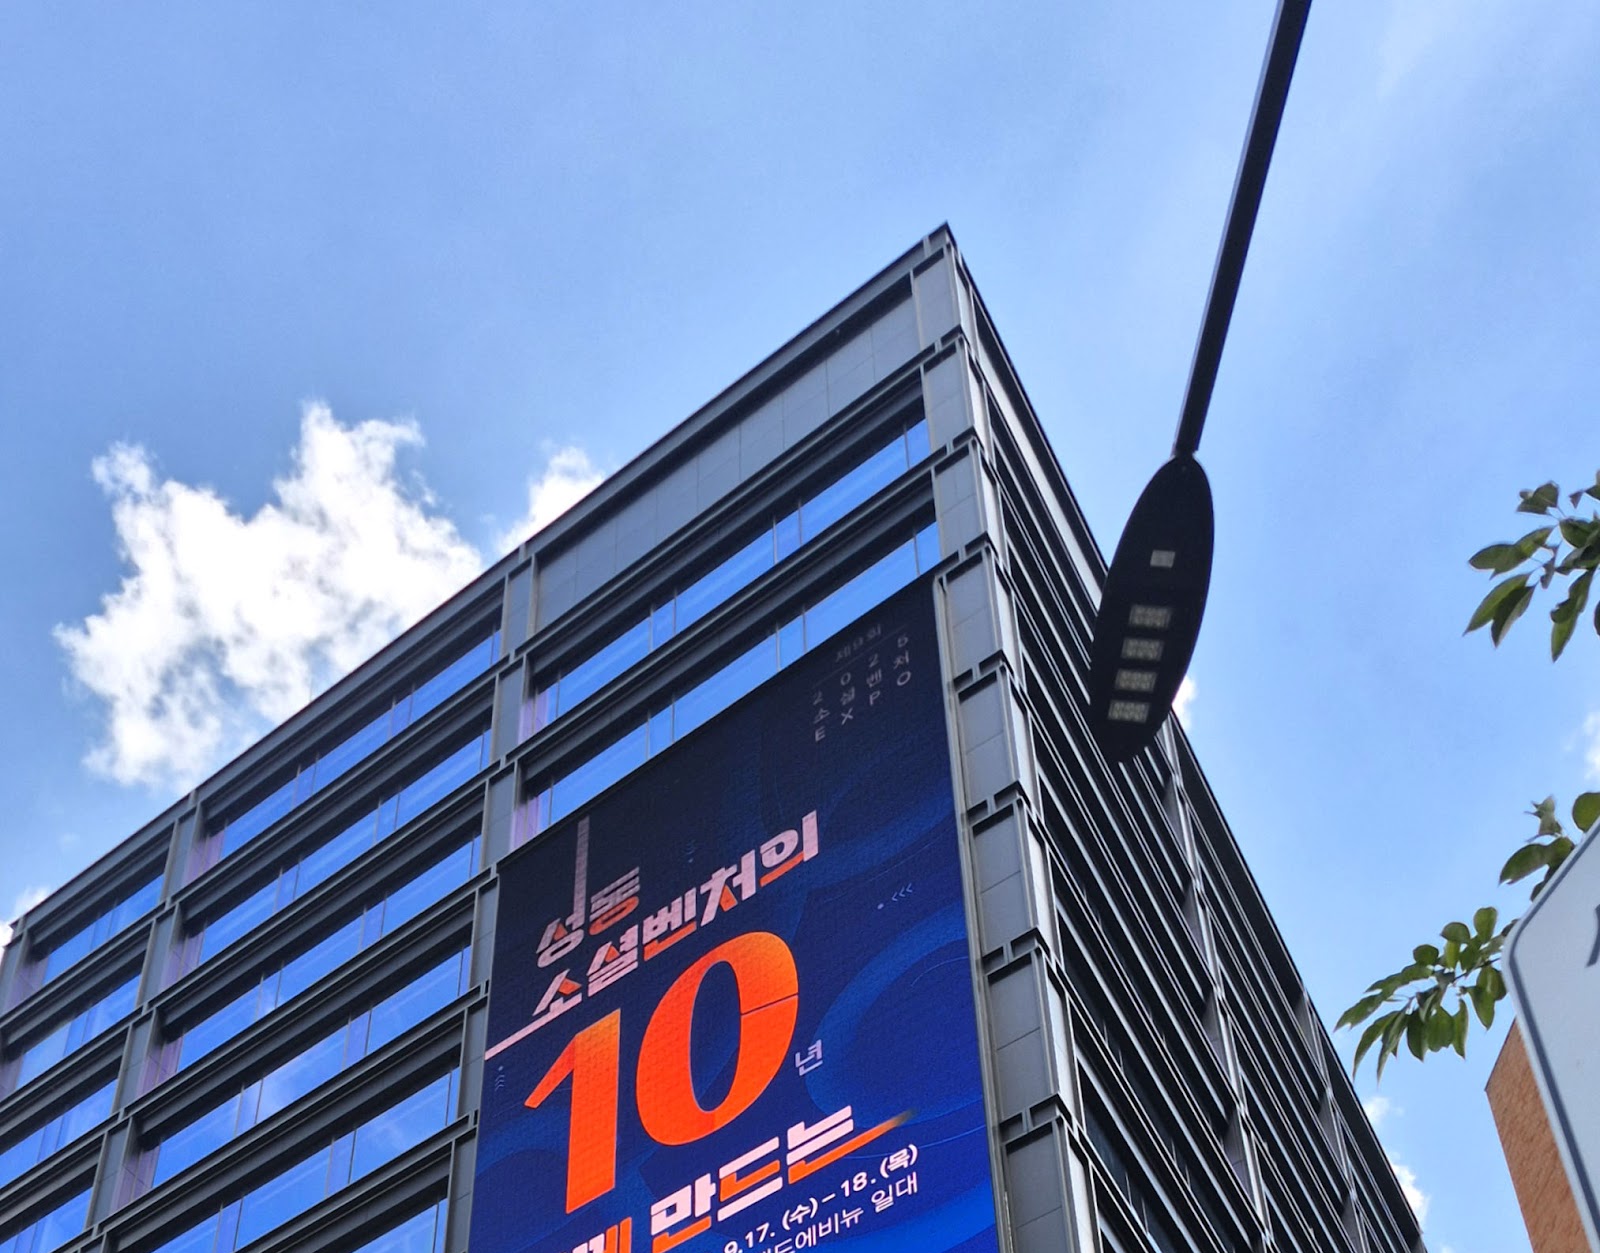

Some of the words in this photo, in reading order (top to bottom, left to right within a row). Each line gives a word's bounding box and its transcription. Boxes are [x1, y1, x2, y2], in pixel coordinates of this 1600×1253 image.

[484, 810, 820, 1061] 소셜벤처의
[536, 815, 640, 968] 성동
[871, 1171, 918, 1213] 일대
